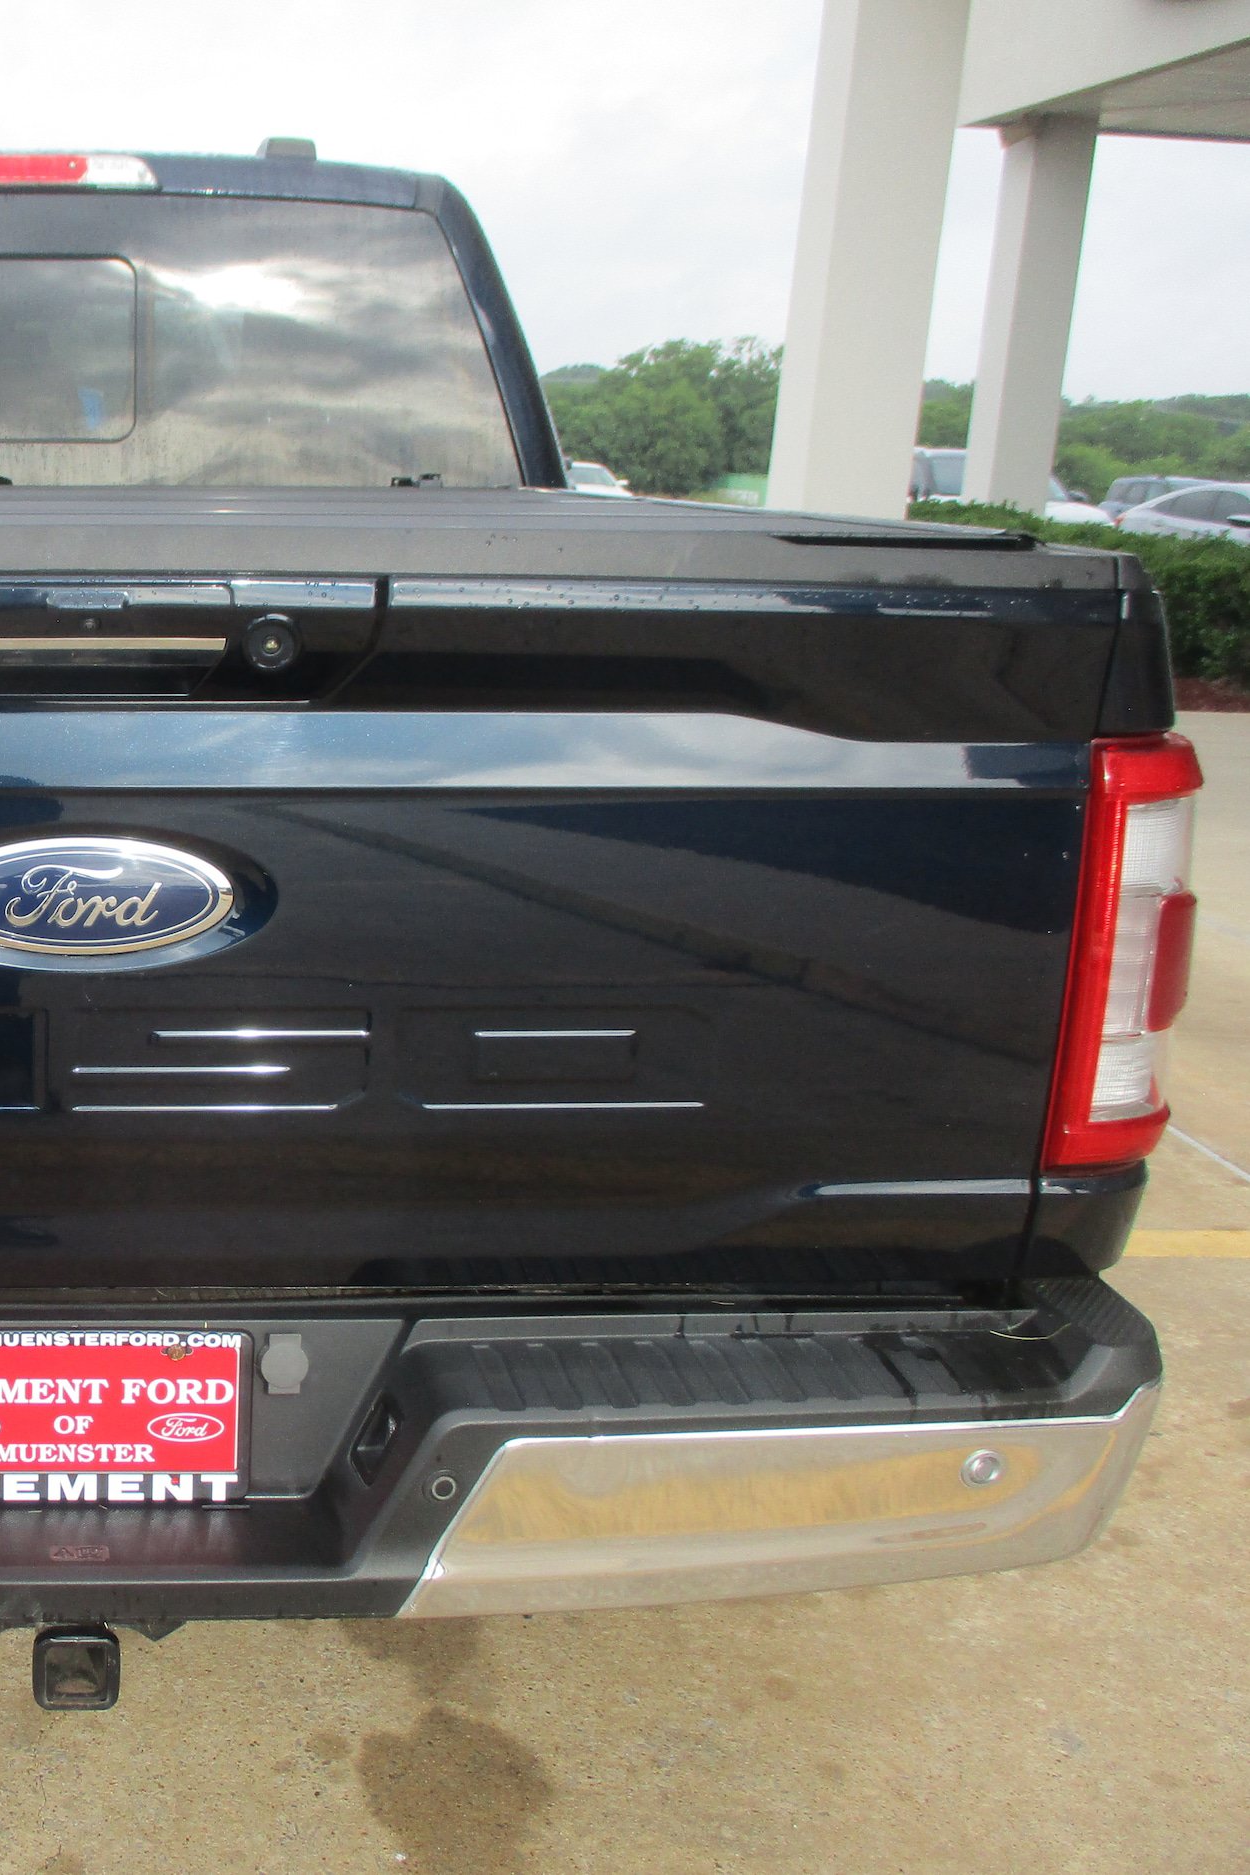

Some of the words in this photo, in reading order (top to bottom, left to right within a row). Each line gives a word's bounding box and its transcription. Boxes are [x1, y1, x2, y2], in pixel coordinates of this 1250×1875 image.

[5, 864, 163, 928] Ford
[121, 1378, 235, 1405] FORD
[53, 1415, 94, 1435] OF
[161, 1416, 209, 1438] Ford
